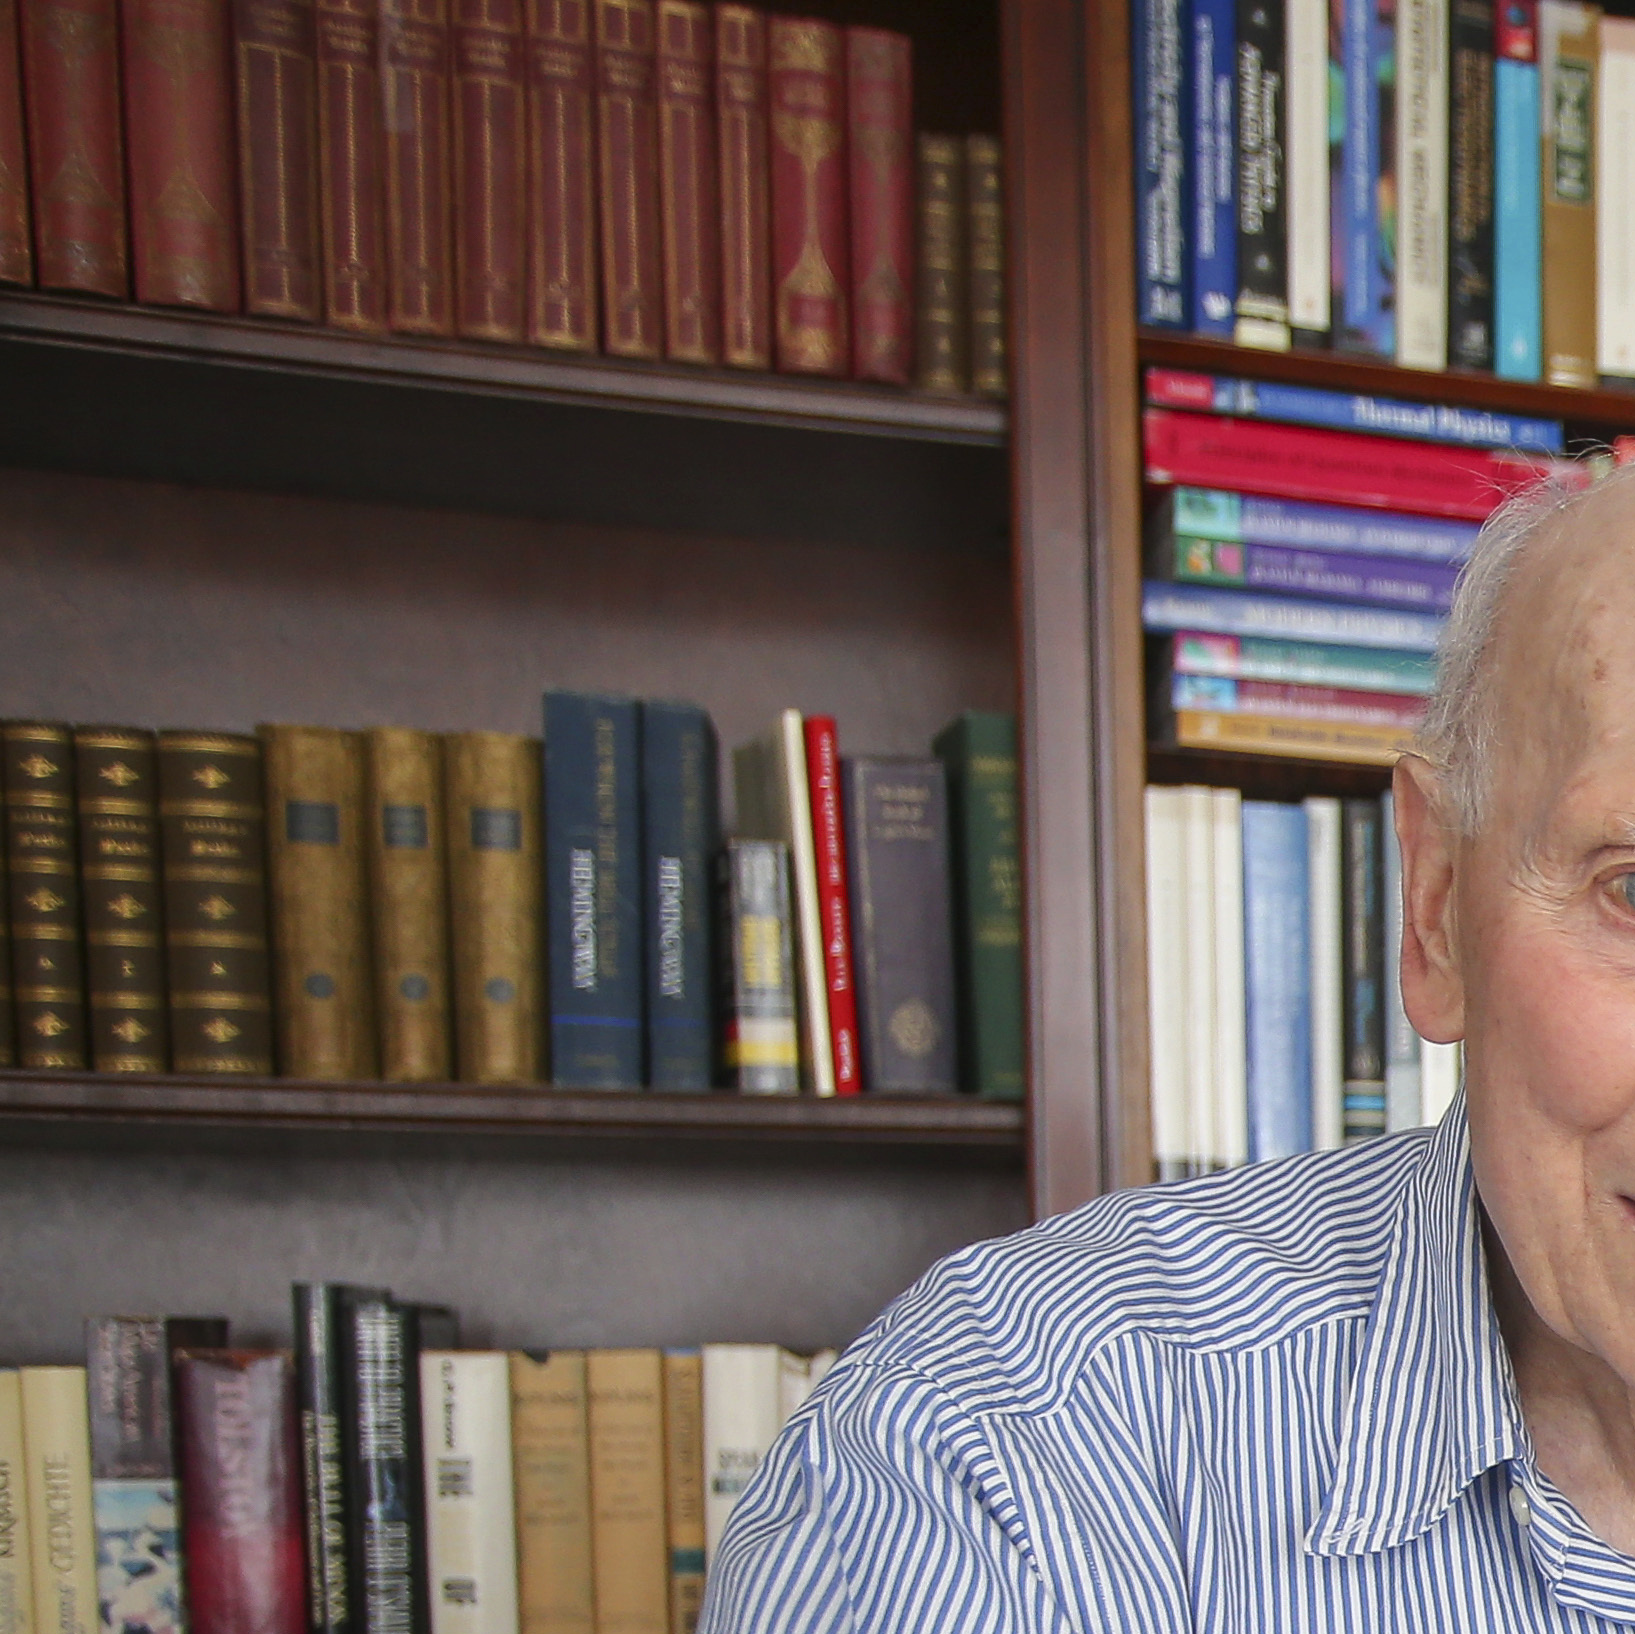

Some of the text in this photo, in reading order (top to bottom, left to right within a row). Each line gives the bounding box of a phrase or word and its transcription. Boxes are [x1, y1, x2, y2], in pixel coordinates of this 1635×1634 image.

[571, 847, 600, 991] HEMINGWAY
[659, 855, 686, 998] HEMINGWAY
[43, 1454, 75, 1574] GEDICHTE
